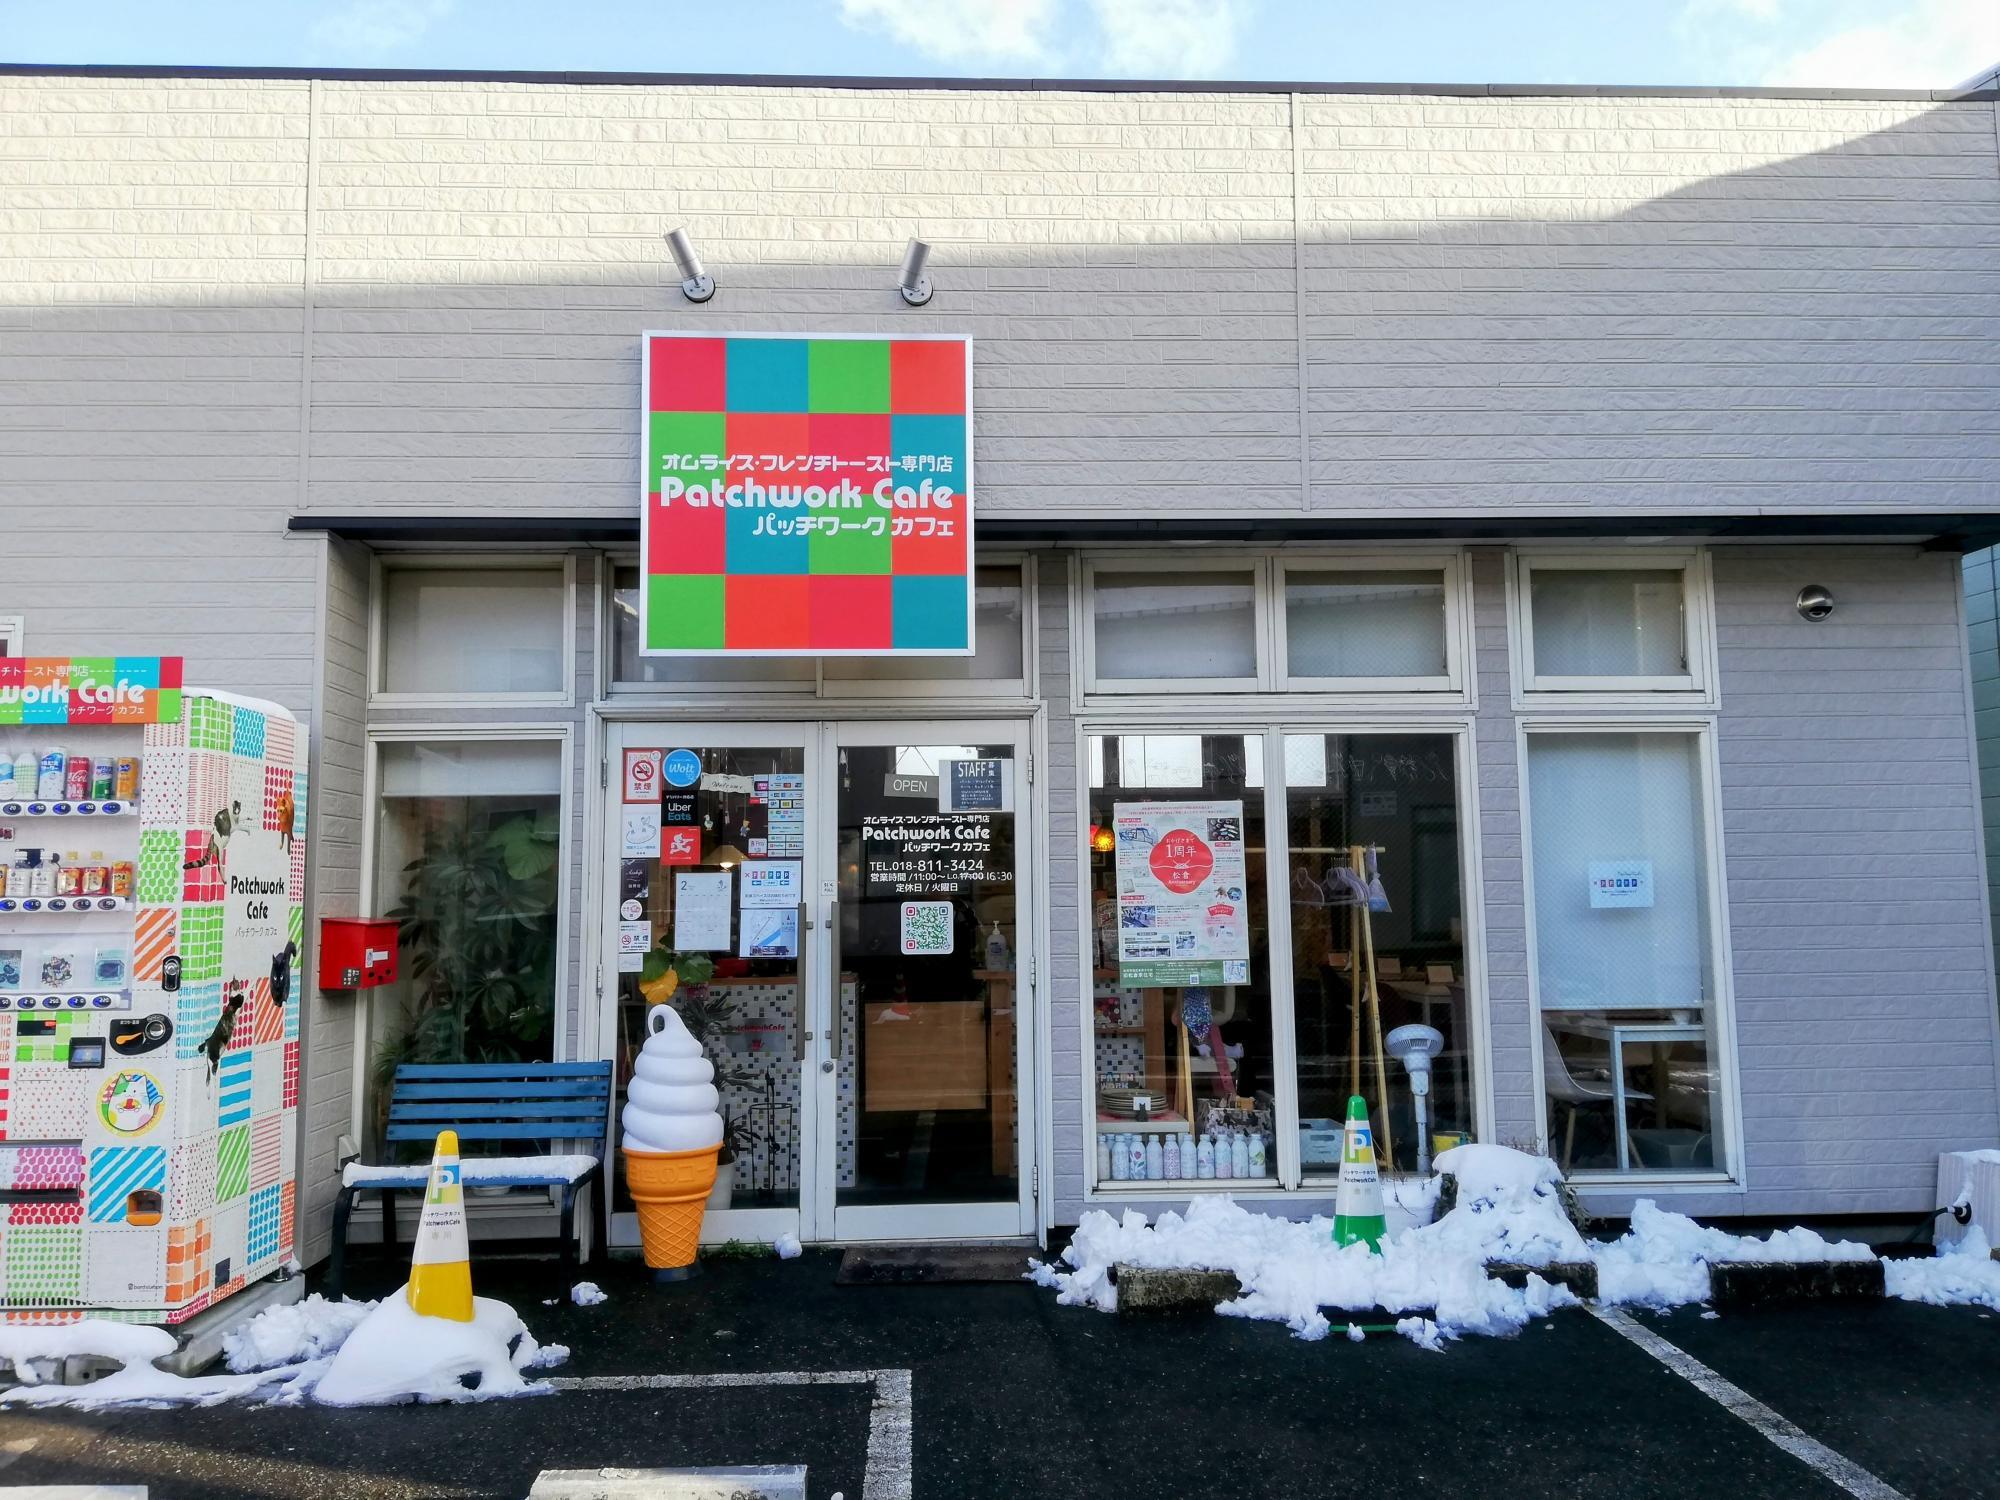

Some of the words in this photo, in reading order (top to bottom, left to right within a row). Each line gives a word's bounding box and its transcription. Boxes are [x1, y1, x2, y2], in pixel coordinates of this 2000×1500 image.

[661, 454, 953, 473] オムライス・フレンチトースト専門店
[660, 476, 863, 508] Patchwork
[872, 478, 954, 509] Cafe
[752, 512, 886, 536] パッチワーク
[891, 516, 954, 536] カフェ
[78, 678, 145, 704] Cafe
[668, 763, 695, 774] Wolt
[958, 762, 986, 777] STAFF
[893, 779, 928, 793] OPEN
[668, 803, 691, 811] Uber
[668, 812, 691, 820] Eats
[863, 815, 990, 824] オムライス・フレンチトースト専門店
[862, 826, 950, 840] Patchwork
[954, 825, 991, 840] Cafe
[902, 842, 960, 852] パッチワーク
[962, 842, 991, 852] カフェ
[1165, 844, 1197, 857] 1周年
[869, 860, 985, 871] TEL.018-811-3424
[870, 873, 907, 882] 営業時間
[231, 876, 284, 894] Patchwork
[681, 881, 687, 890] 2
[895, 883, 922, 892] 定休日
[931, 883, 958, 892] 火曜日
[246, 900, 268, 919] Cafe
[1349, 1133, 1367, 1159] P
[431, 1170, 454, 1199] P
